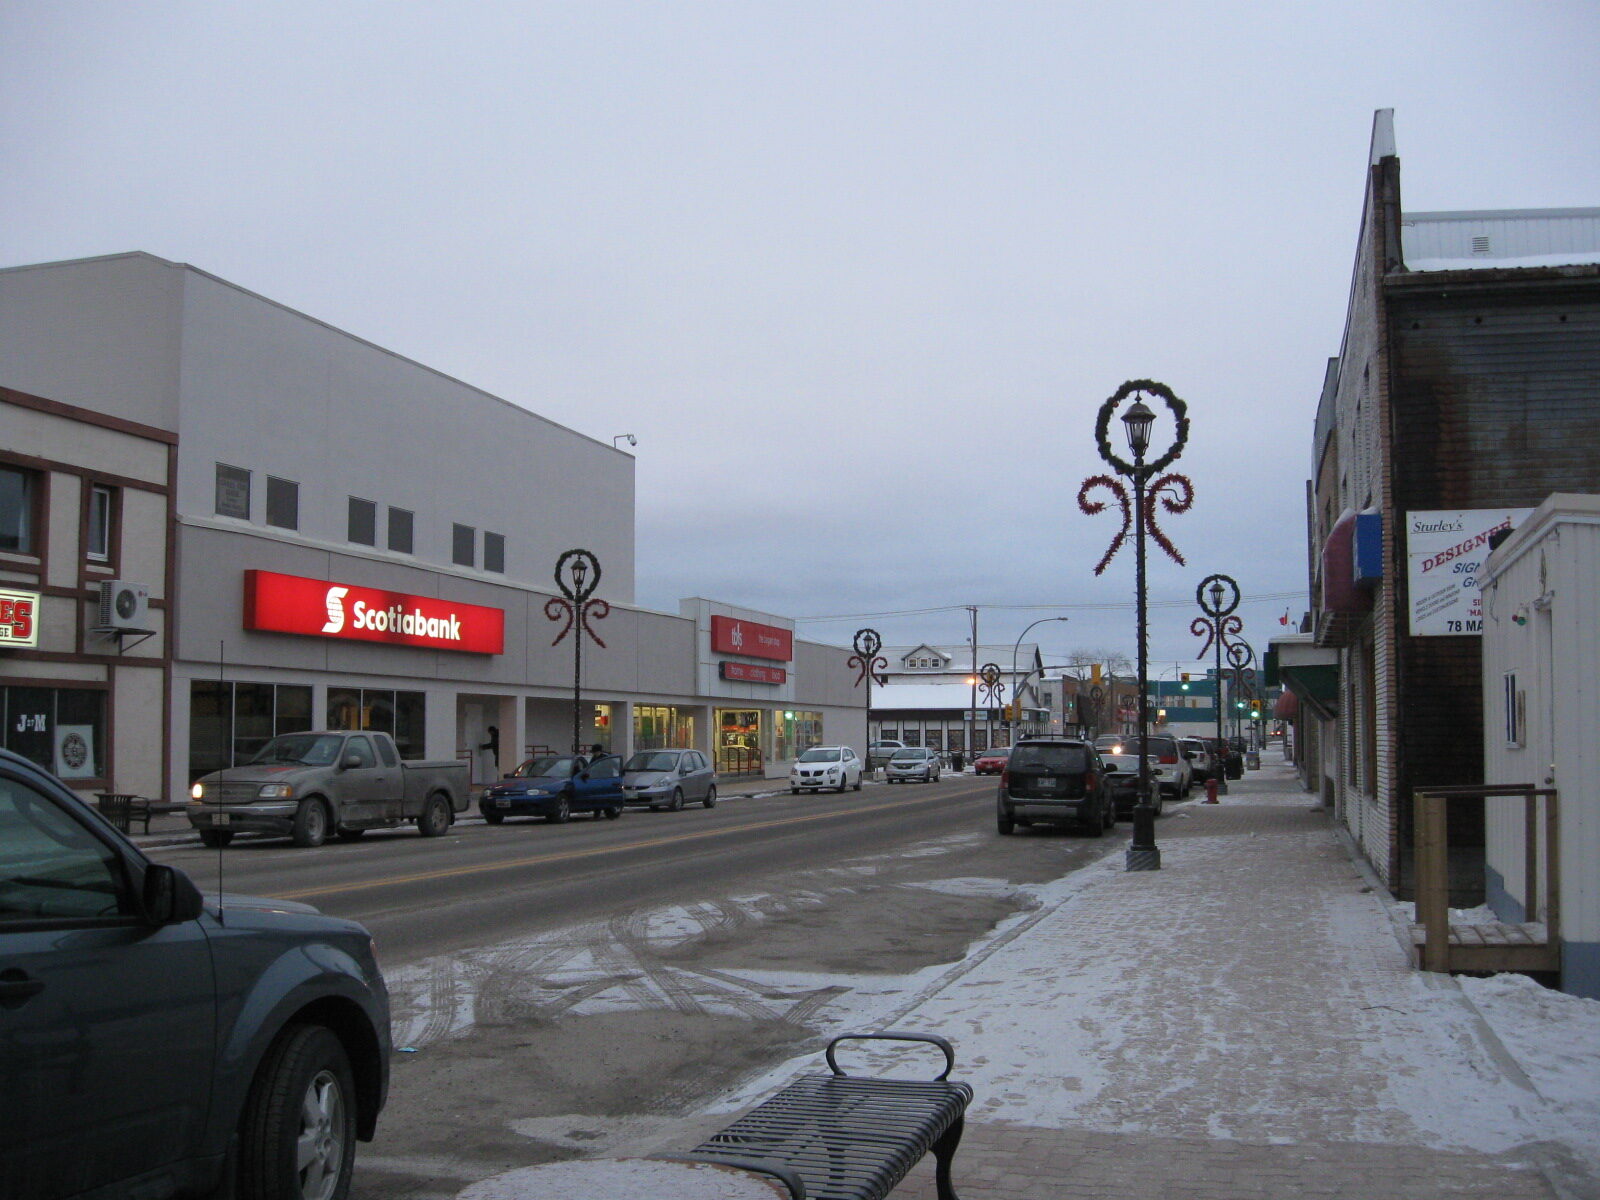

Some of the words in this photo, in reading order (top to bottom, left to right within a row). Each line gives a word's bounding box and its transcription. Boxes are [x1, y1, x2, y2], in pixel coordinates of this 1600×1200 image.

[1413, 520, 1463, 533] Sturley's
[353, 600, 461, 641] Scotiabank
[1447, 620, 1462, 632] 78
